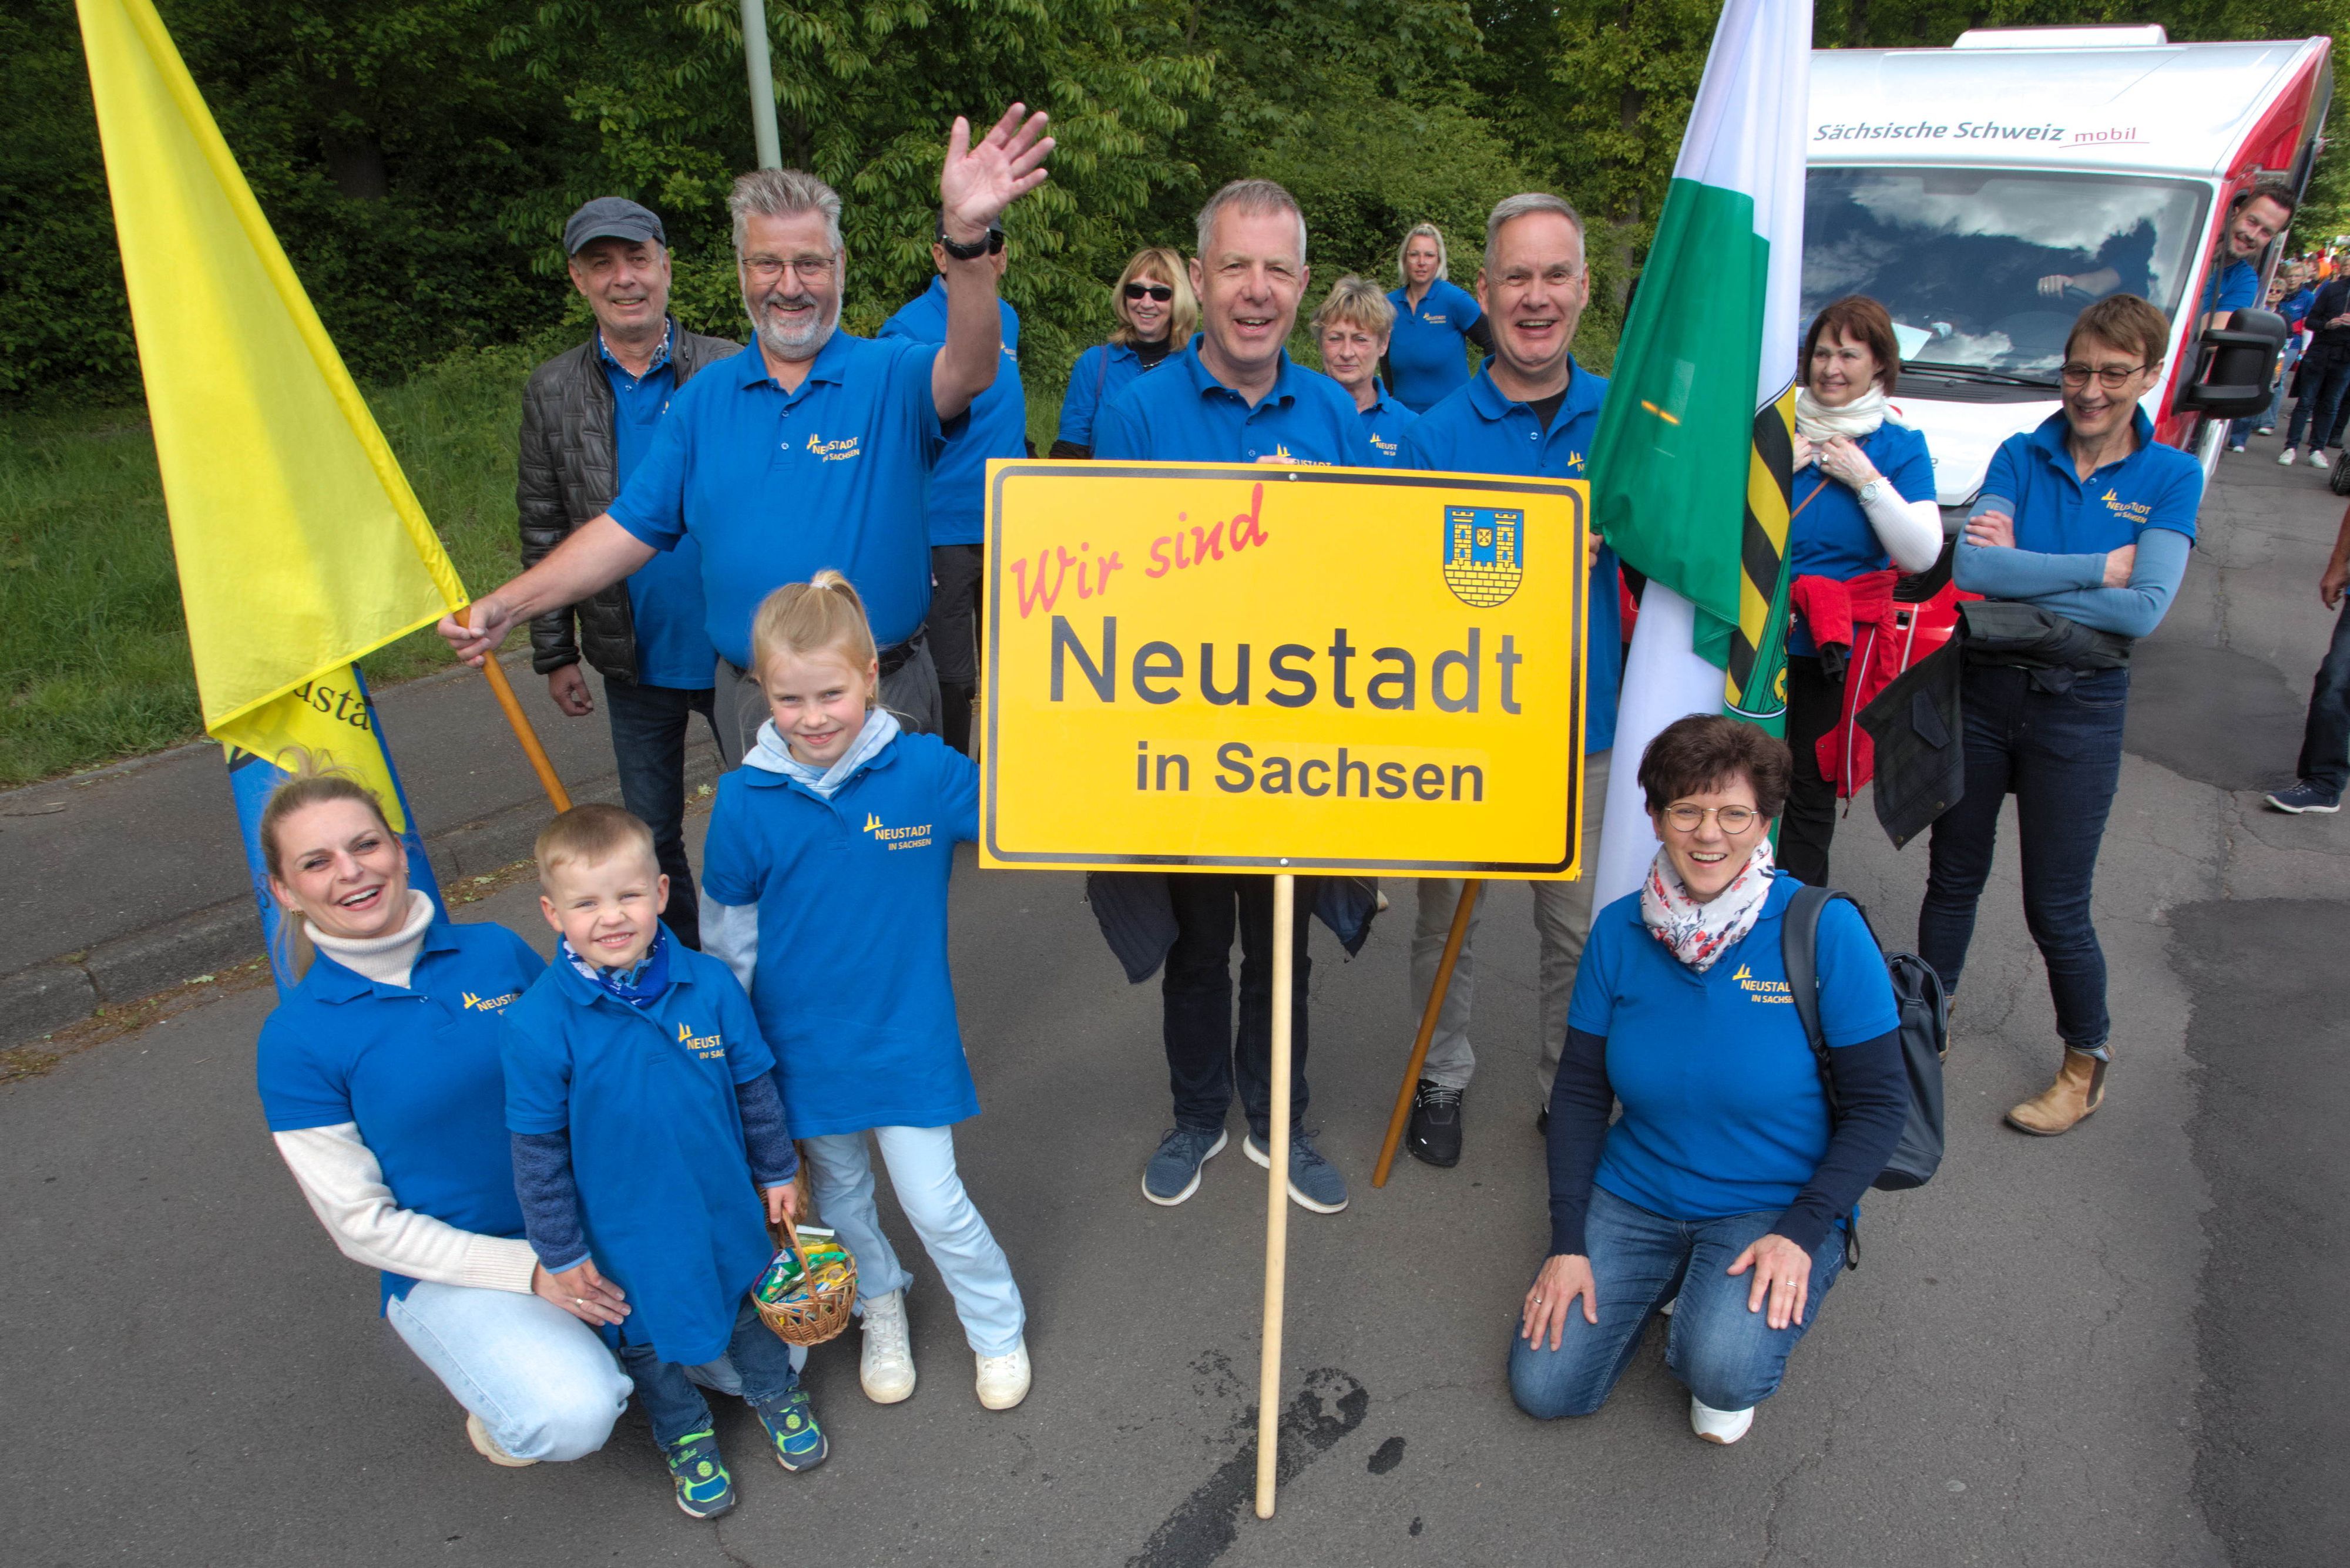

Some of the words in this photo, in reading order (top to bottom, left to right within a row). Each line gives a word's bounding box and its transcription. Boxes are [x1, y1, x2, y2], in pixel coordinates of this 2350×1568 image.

[1813, 121, 1948, 141] Sächsische
[1953, 120, 2066, 141] Schweiz
[2075, 127, 2136, 143] mobil
[1376, 442, 1397, 451] NEUST
[1010, 542, 1123, 619] Wir
[1145, 482, 1268, 578] sind
[1050, 615, 1523, 715] Neustadt
[1137, 740, 1189, 791] in
[1215, 741, 1484, 803] Sachsen
[875, 824, 932, 840] NEUSTADT
[898, 838, 932, 850] SACHSEN
[1740, 980, 1791, 992] NEUSTA
[1751, 995, 1761, 1003] IN
[686, 1035, 721, 1050] NEUST
[710, 1049, 725, 1059] SAC
